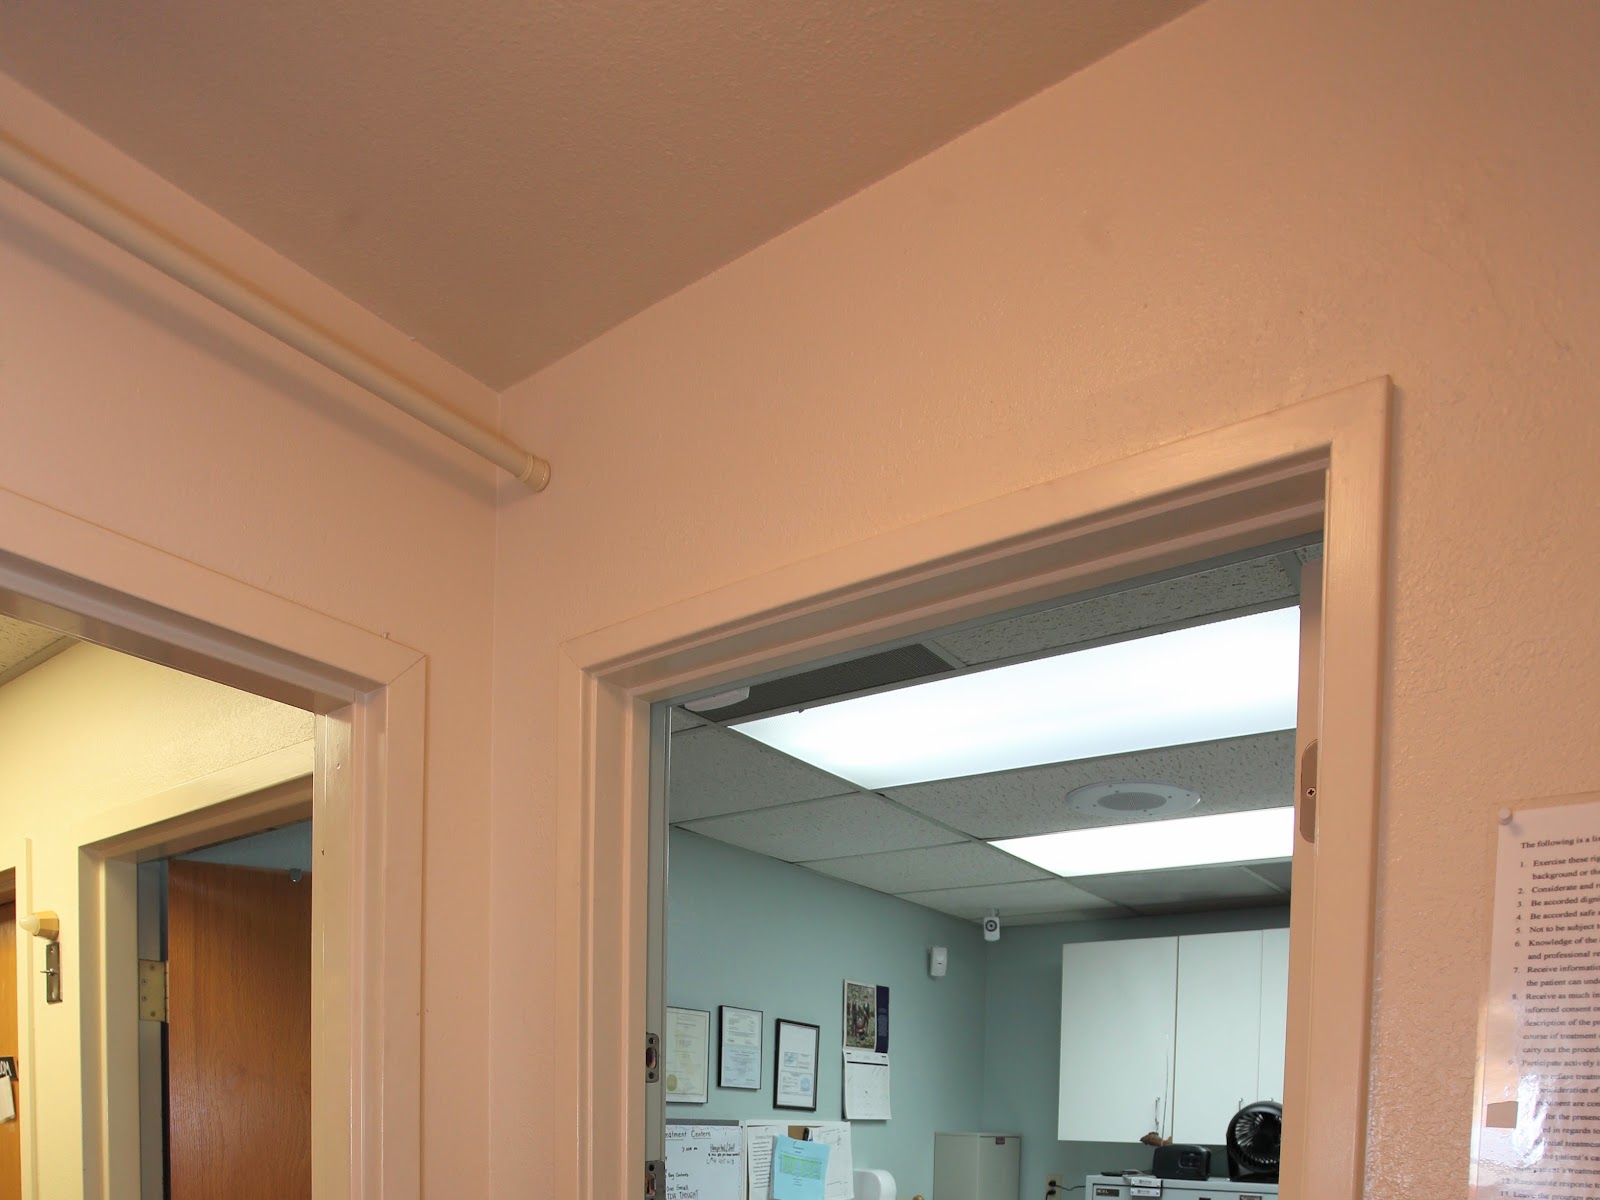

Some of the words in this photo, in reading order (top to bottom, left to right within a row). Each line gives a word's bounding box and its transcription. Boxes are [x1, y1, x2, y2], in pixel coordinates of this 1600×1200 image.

[1537, 839, 1574, 847] following
[1533, 859, 1566, 867] Exercise
[1532, 870, 1578, 880] background
[1532, 885, 1577, 893] Considerate
[1544, 897, 1578, 905] accorded
[1543, 911, 1577, 919] accorded
[1529, 938, 1572, 946] Knowledge
[1544, 951, 1590, 960] professional
[1540, 979, 1566, 987] patient
[1563, 1127, 1591, 1135] regards
